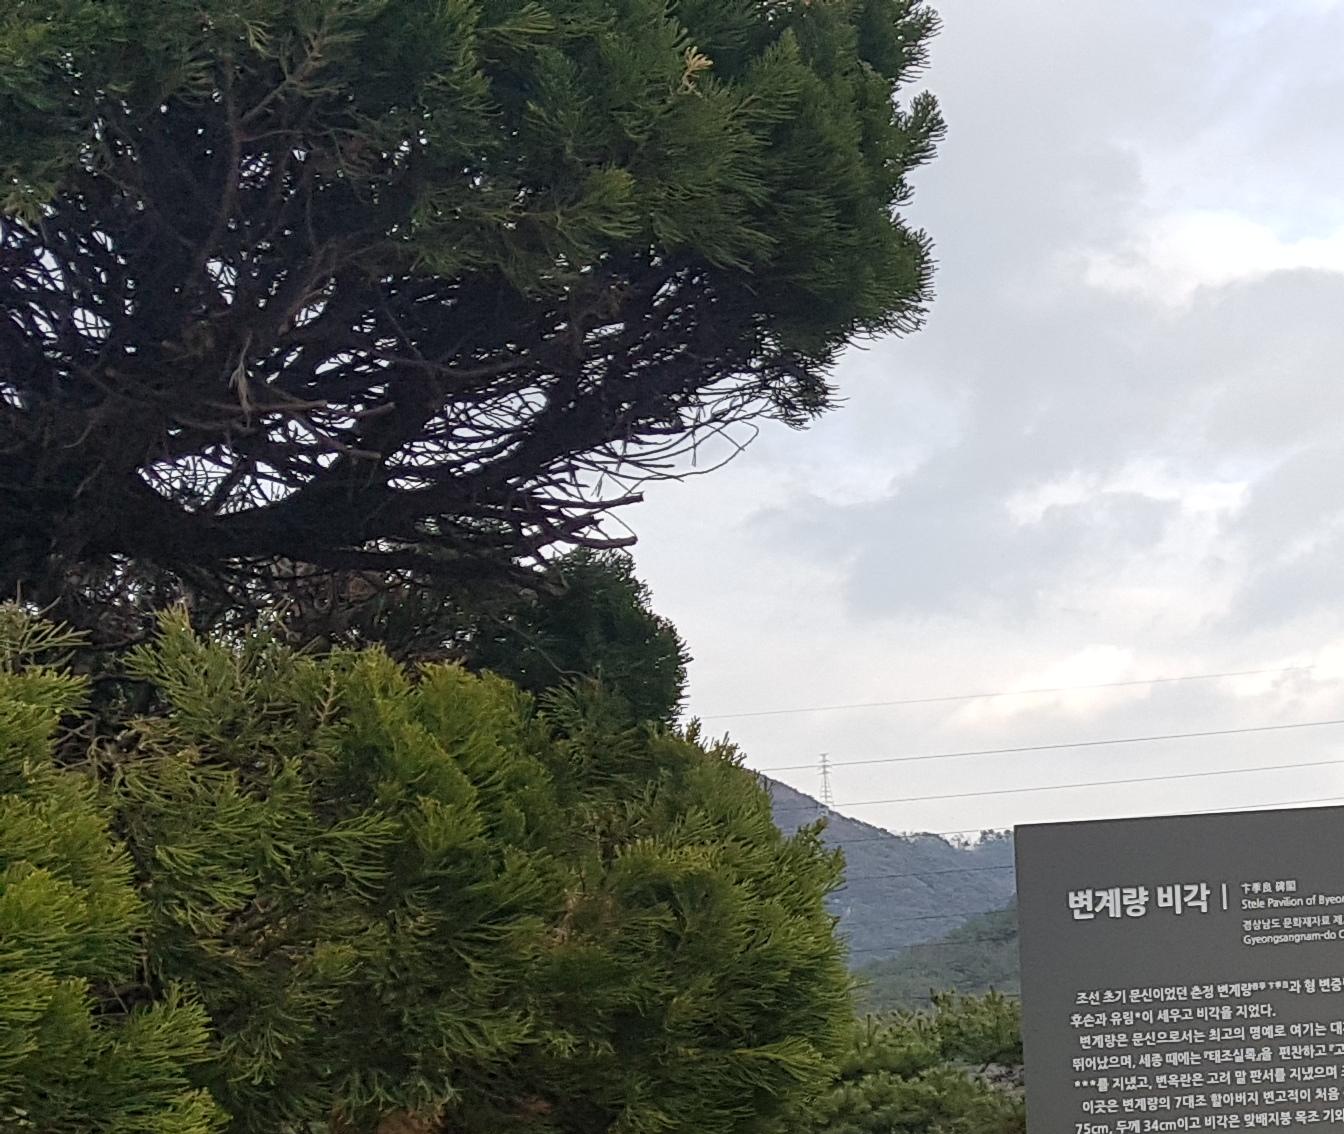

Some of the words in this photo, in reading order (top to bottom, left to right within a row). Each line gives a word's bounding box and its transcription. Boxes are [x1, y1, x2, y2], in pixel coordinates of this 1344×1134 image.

[1068, 885, 1149, 919] 변계량
[1156, 882, 1210, 914] 비각
[1241, 897, 1265, 909] Stele
[1267, 896, 1303, 907] Pavilion
[1305, 894, 1316, 905] of
[1242, 918, 1280, 931] 경상남도
[1282, 915, 1330, 928] 문화재자료
[1243, 929, 1336, 945] Gyeongsangnam-do
[1075, 990, 1100, 1005] 조선
[1102, 989, 1126, 1003] 초기
[1128, 986, 1187, 1002] 문신이었던
[1303, 978, 1315, 993] 형
[1069, 1012, 1107, 1028] 후손과
[1156, 1008, 1193, 1022] 세우고
[1196, 1005, 1232, 1020] 비각을
[1235, 1003, 1276, 1018] 지었다.
[1079, 1033, 1128, 1049] 변계량은
[1131, 1029, 1205, 1046] 문신으로서는
[1208, 1026, 1245, 1041] 최고의
[1249, 1024, 1286, 1040] 명예로
[1289, 1022, 1327, 1037] 여기는
[1072, 1054, 1136, 1071] 뛰어났으며,
[1138, 1052, 1162, 1067] 세종
[1165, 1051, 1201, 1065] 때에는
[1278, 1044, 1327, 1059] 편찬하고
[1111, 1075, 1152, 1091] 지냈고,
[1155, 1072, 1204, 1088] 변옥란은
[1206, 1070, 1230, 1084] 고려
[1249, 1067, 1285, 1083] 판서를
[1289, 1064, 1337, 1081] 지냈으며
[1082, 1098, 1119, 1114] 이곳은
[1122, 1095, 1170, 1112] 변계량의
[1173, 1094, 1207, 1108] 7대조
[1262, 1088, 1310, 1104] 변고적이
[1314, 1086, 1340, 1101] 처음
[1075, 1122, 1112, 1134] 75cm,
[1115, 1119, 1140, 1134] 두께
[1143, 1116, 1201, 1131] 34cm이고
[1204, 1114, 1240, 1129] 비각은
[1243, 1111, 1292, 1127] 맞배지붕
[1294, 1110, 1320, 1124] 목조
